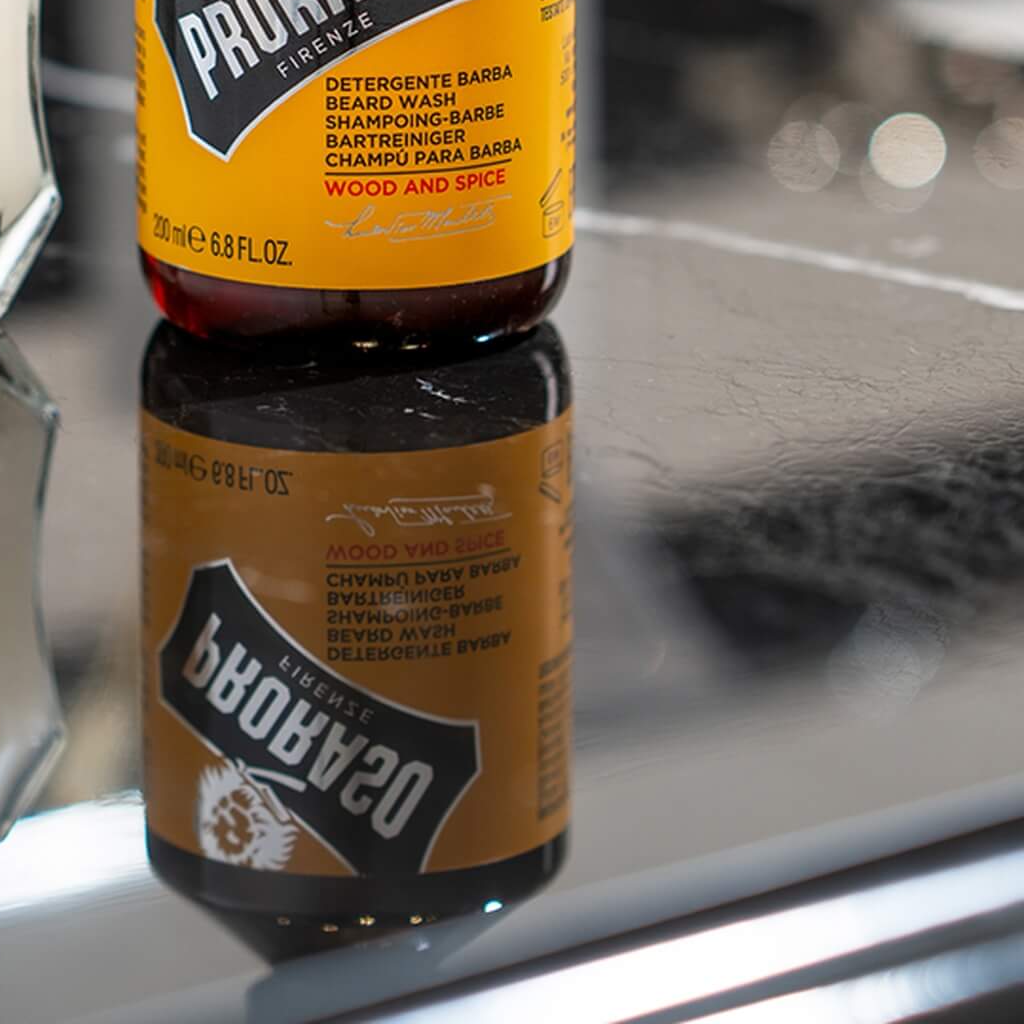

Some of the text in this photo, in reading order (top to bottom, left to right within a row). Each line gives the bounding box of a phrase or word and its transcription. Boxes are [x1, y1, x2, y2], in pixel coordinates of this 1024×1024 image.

[276, 10, 374, 79] FIRENZE
[325, 66, 513, 93] DETERGENTE BARBA
[325, 92, 457, 112] BEARD WASH
[325, 104, 505, 130] SHAMPOING-BARBE
[325, 129, 466, 149] BARTREINIGER
[325, 138, 523, 168] CHAMPÚ PARA BARBA
[324, 169, 506, 197] WOOD AND SPICE
[210, 231, 234, 259] 6.8
